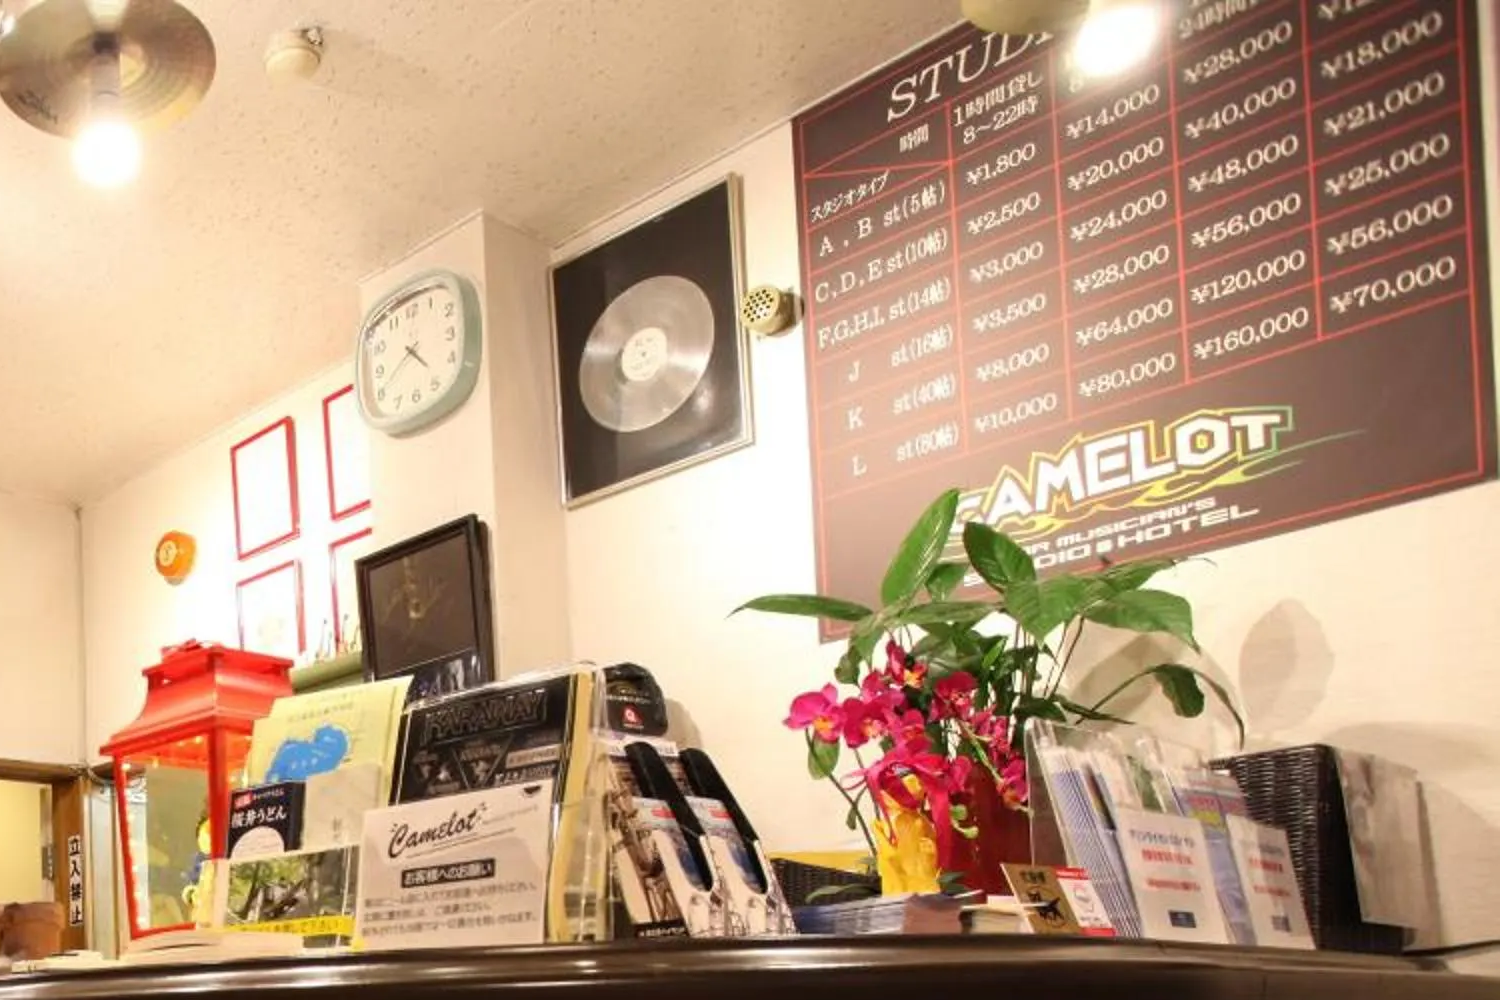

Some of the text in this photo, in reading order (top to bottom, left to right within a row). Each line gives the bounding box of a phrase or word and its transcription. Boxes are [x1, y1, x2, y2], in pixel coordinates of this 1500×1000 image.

[1183, 20, 1293, 84] ¥28,000
[1320, 10, 1443, 79] ¥18,000
[1065, 83, 1160, 140] ¥14,000
[1184, 77, 1296, 139] ¥40,000
[1323, 72, 1445, 136] ¥21,000
[899, 124, 929, 153] 時間
[965, 143, 1036, 184] ¥1,800
[1067, 137, 1164, 191] ¥20,000
[1188, 134, 1299, 193] ¥48,000
[1324, 133, 1450, 197] ¥25,000
[810, 168, 890, 222] スタジオタイプ
[967, 192, 1041, 235] ¥2,500
[1070, 189, 1167, 241] ¥24,000
[1191, 192, 1301, 248] ¥56,000
[1326, 195, 1453, 255] ¥56,000
[970, 242, 1044, 282] ¥3,000
[1073, 244, 1170, 294] ¥28,000
[1191, 249, 1305, 304] ¥120,000
[1329, 256, 1456, 314] ¥70,000
[972, 293, 1047, 332] ¥3,500
[1075, 298, 1173, 347] ¥64,000
[1193, 306, 1309, 360] ¥160,000
[848, 360, 861, 383] J
[976, 343, 1050, 382] ¥8,000
[1078, 352, 1176, 397] ¥80,000
[847, 406, 865, 431] K
[974, 393, 1058, 433] ¥10,000
[1056, 496, 1216, 548] MUSICIAN'S
[69, 836, 84, 925] 立入禁止
